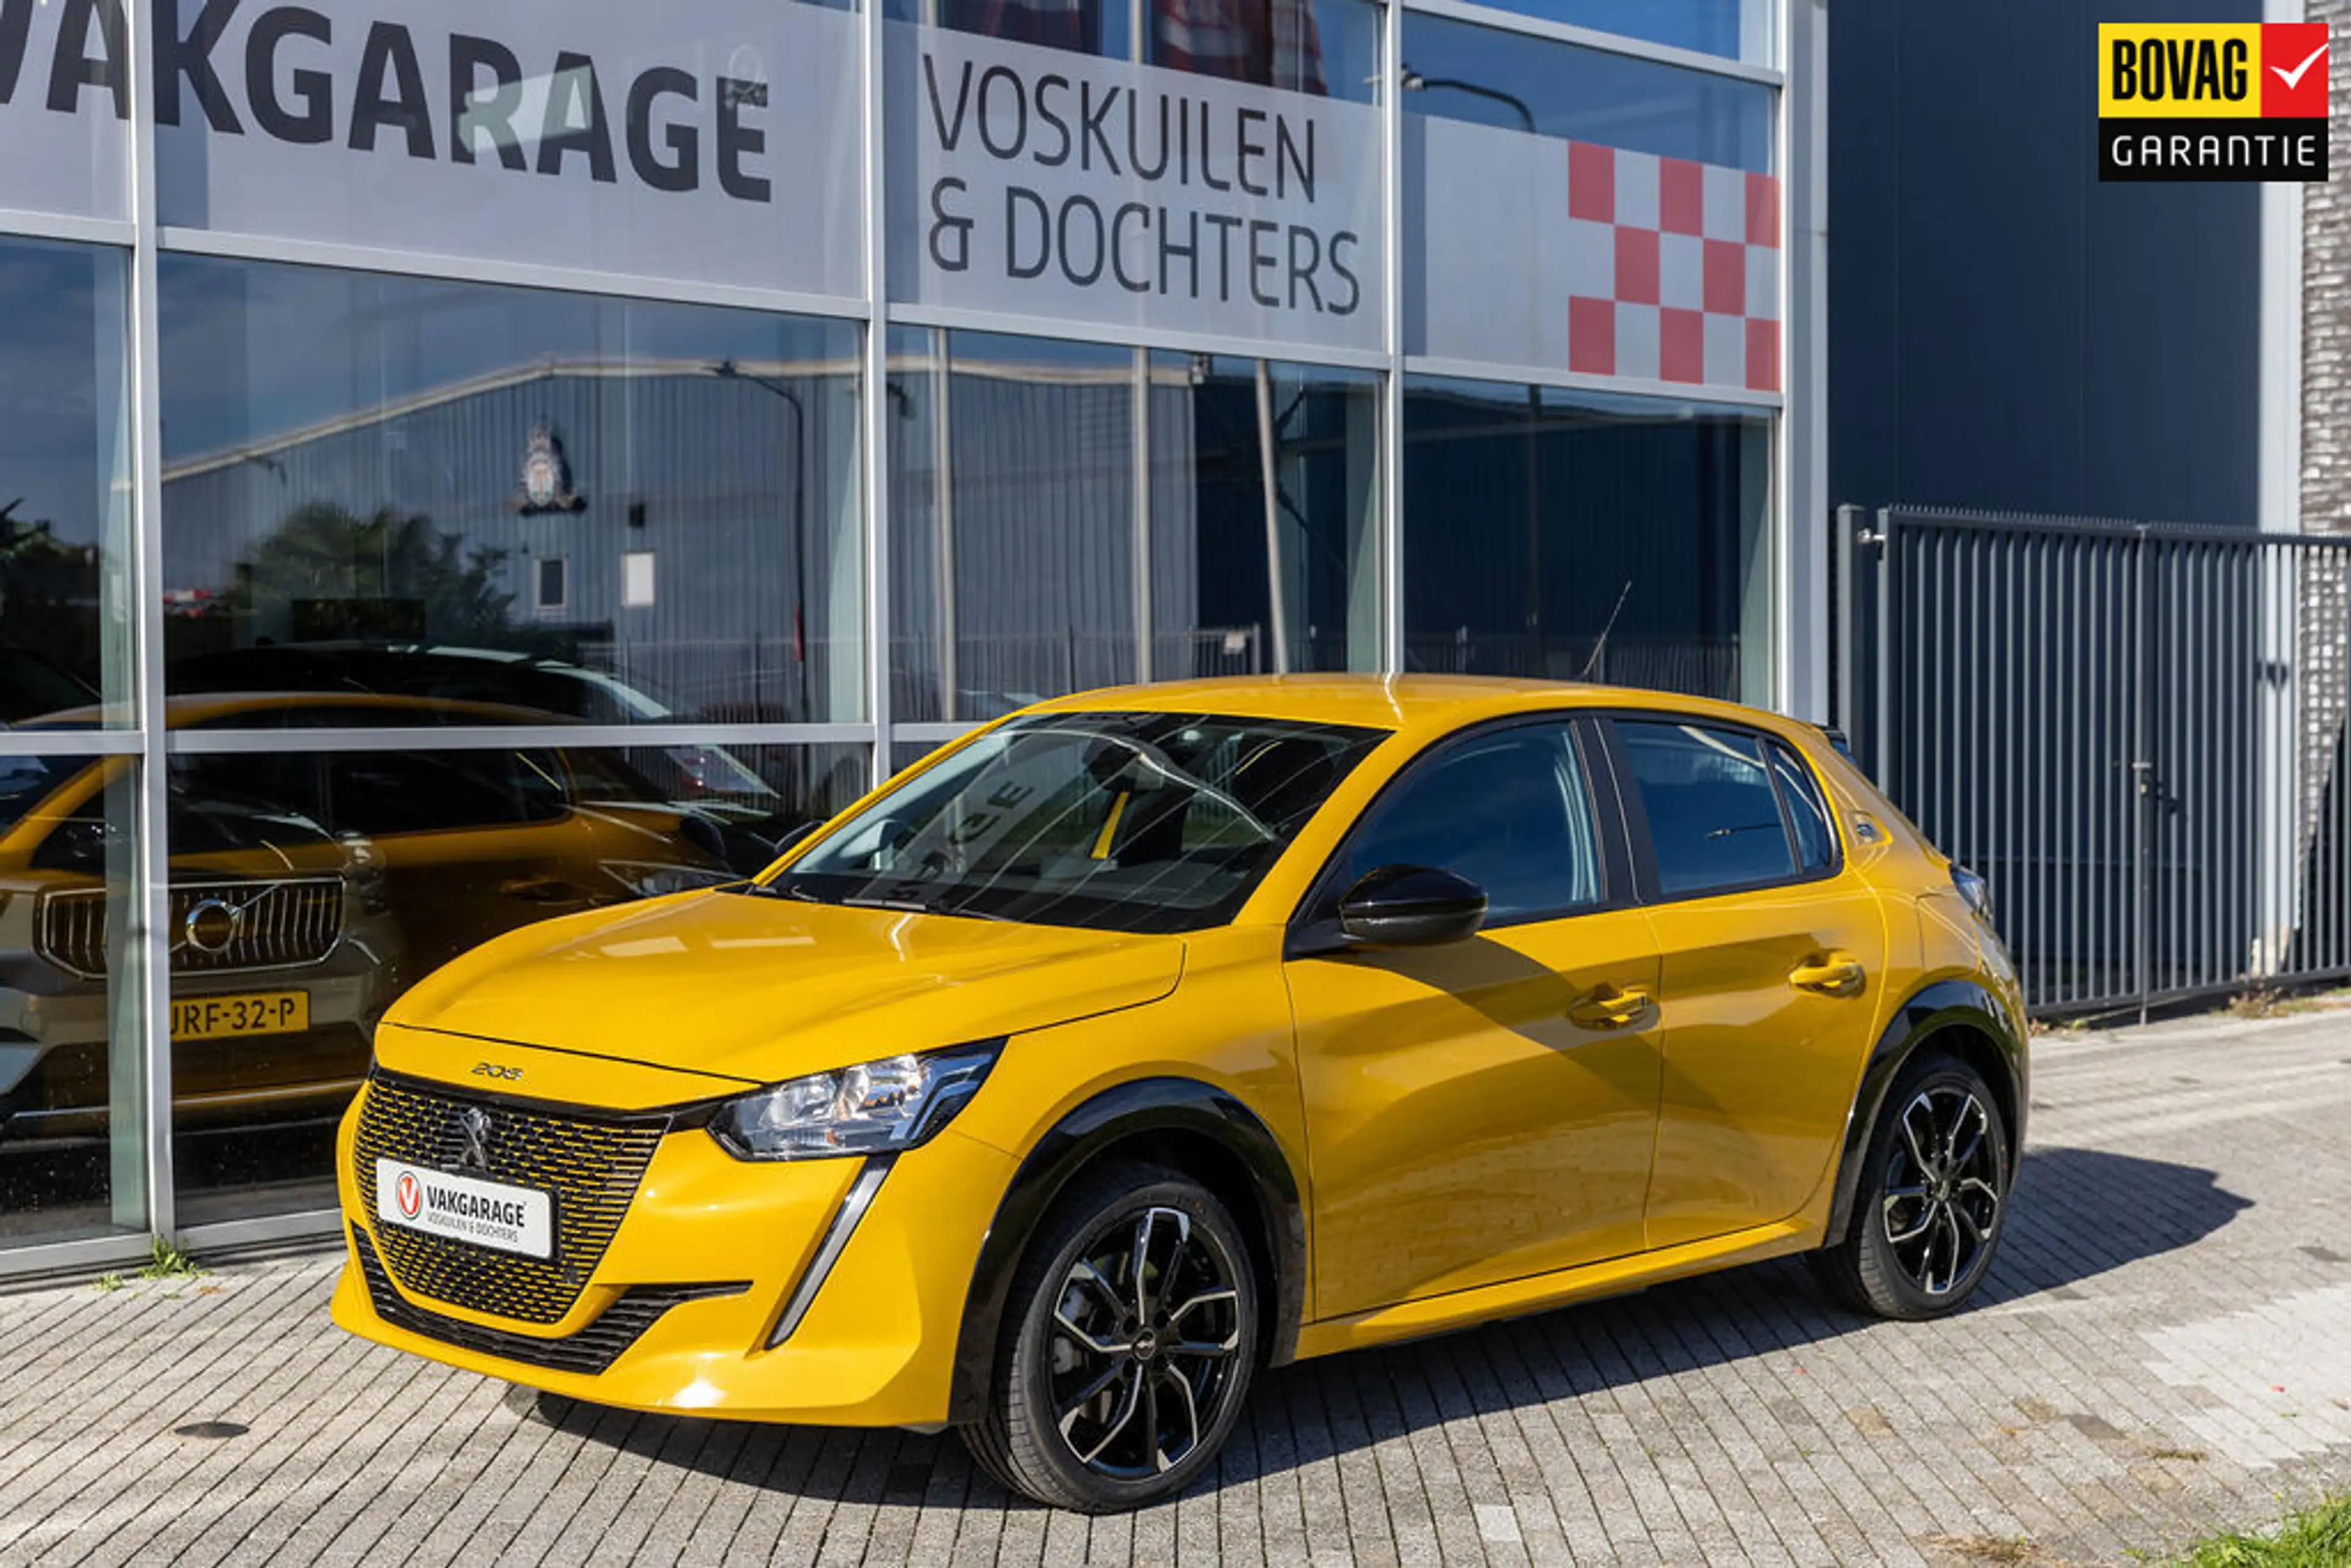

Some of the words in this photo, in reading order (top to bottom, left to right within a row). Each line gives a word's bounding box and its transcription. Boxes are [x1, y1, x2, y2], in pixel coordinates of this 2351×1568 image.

[923, 54, 1314, 203] VOSKUILEN
[929, 177, 973, 272] &
[1006, 186, 1359, 315] DOCHTERS
[427, 1186, 525, 1227] VAKGARAGE
